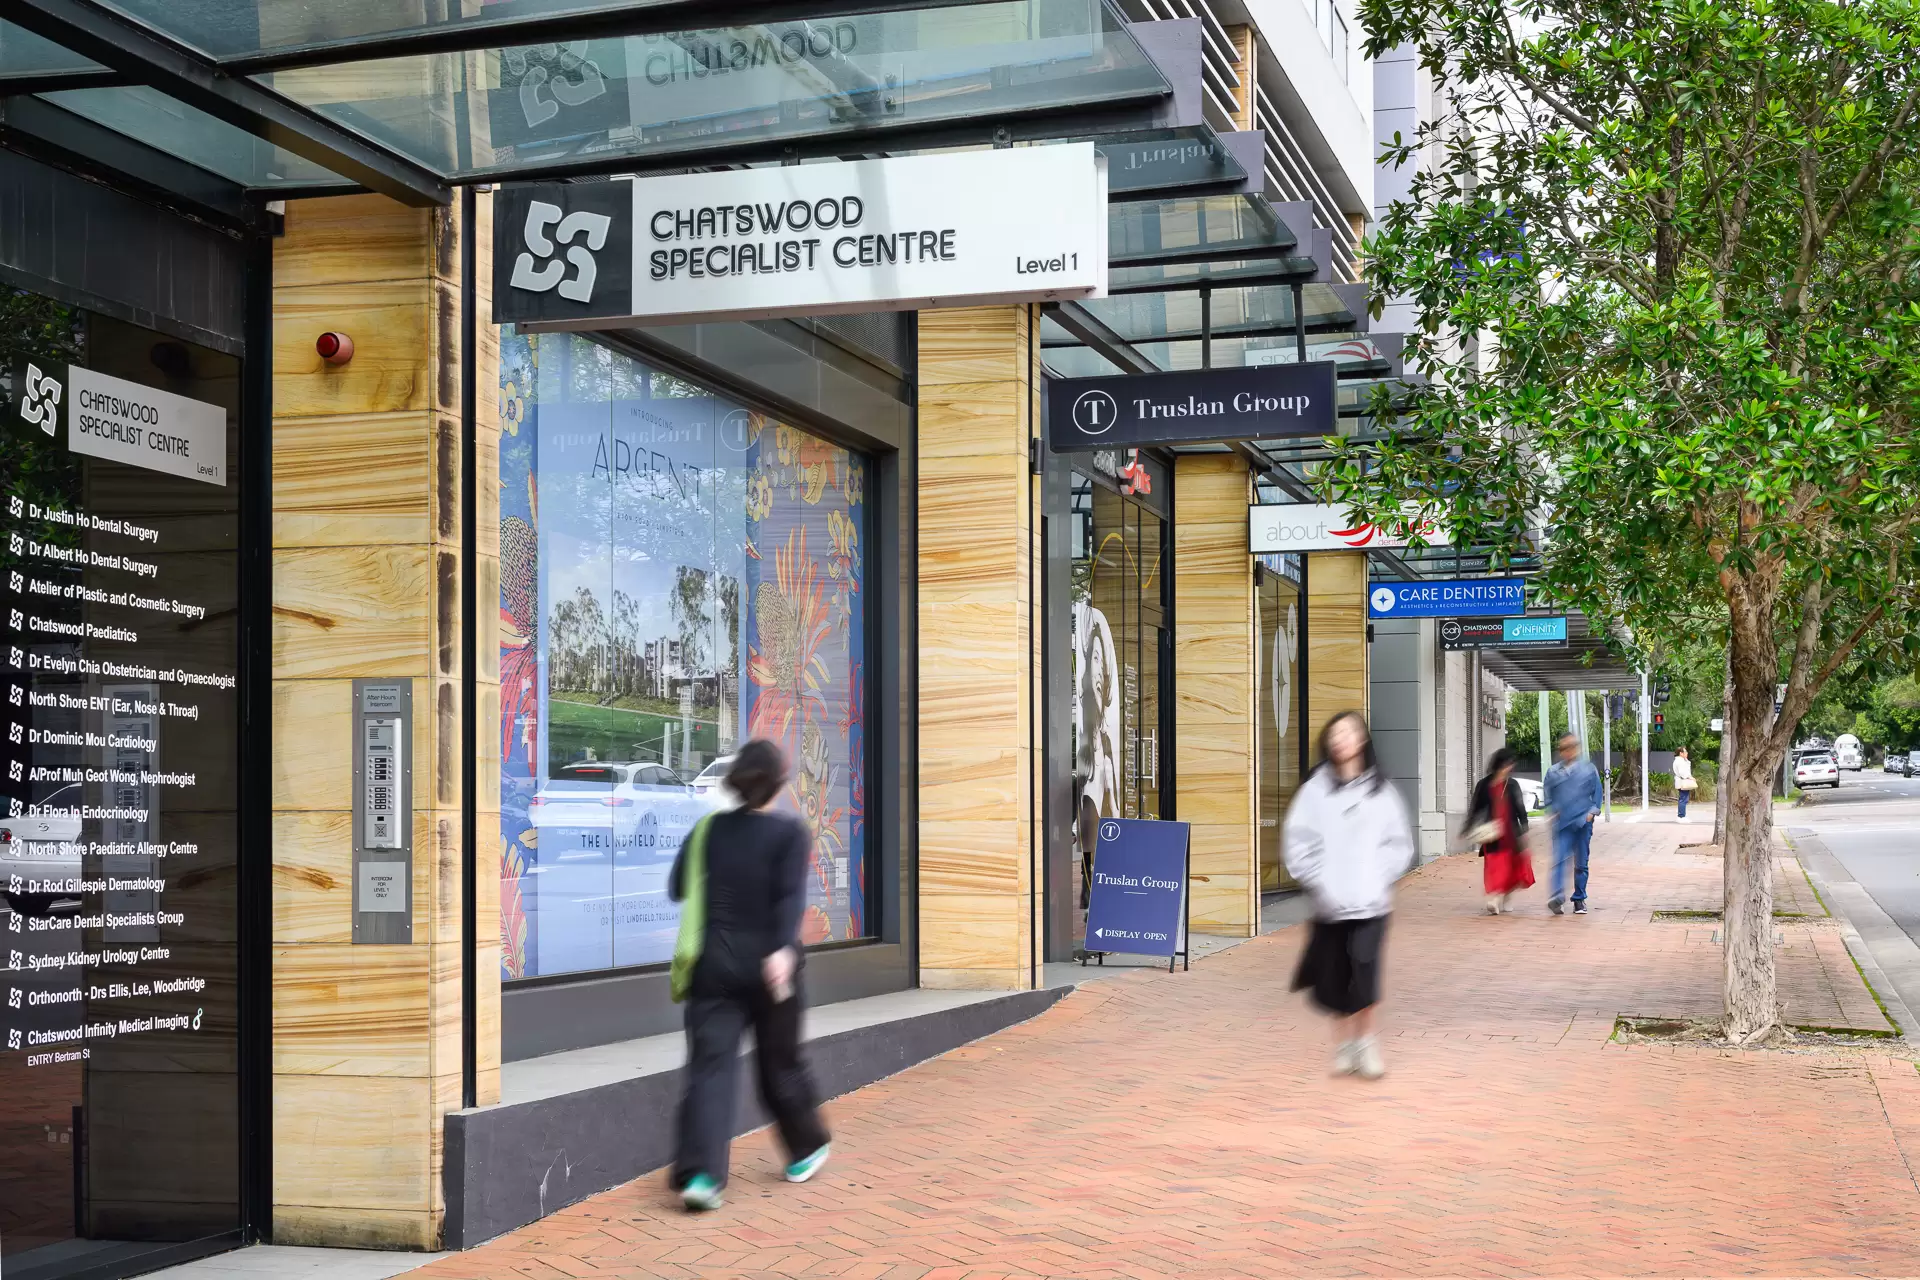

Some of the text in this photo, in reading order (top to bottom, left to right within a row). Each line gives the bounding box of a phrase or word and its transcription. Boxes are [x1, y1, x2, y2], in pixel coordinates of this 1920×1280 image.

[650, 196, 863, 241] CHATSWOOD
[650, 229, 957, 282] SPECIALIST CENTRE
[1017, 253, 1077, 275] Level 1
[80, 390, 158, 425] CHATSWOOD
[1084, 392, 1310, 425] T Truslan Group
[631, 408, 674, 431] INTRODUCING
[80, 415, 190, 458] SPECIALIST CENTRE
[197, 463, 214, 476] Level
[592, 432, 701, 511] ARGENT
[30, 504, 158, 543] Dr Justin Ho Dental Surgery
[1266, 521, 1328, 542] about
[30, 542, 158, 578] Dr Albert Ho Dental Surgery
[29, 579, 205, 620] Atelier of Plastic and Cosmetic Surgery
[1400, 586, 1524, 601] CARE DENTISTRY
[29, 617, 137, 642] Chatswood Paediatrics
[1522, 625, 1558, 633] INFINITY
[29, 654, 235, 690] Dr Evelyn Chia Obstetrician and Gynaecologist
[29, 692, 199, 721] North Shore ENT (Ear, Nose & Throat)
[29, 729, 157, 752] Dr Dominic Mou Cardiology
[29, 767, 196, 788] A/Prof Muh Geot Wong, Nephrologist
[29, 804, 149, 823] Dr Flora Ip Endocrinology
[29, 841, 198, 857] North Shore Paediatric Allergy Centre
[582, 835, 600, 848] THE
[606, 835, 655, 848] LNDFIELD
[29, 876, 166, 895] Dr Rod Gillespie Dermatology
[1096, 873, 1179, 891] Truslan Group
[29, 911, 184, 932] StarCare Dental Specialists Group
[1105, 930, 1168, 941] DISPLAY OPEN
[29, 947, 170, 972] Sydney Kidney Urology Centre
[29, 988, 82, 1006] Orthonorth
[90, 986, 107, 1000] Drs
[109, 984, 131, 999] Ellis,
[133, 982, 152, 997] Lee,
[154, 977, 206, 994] Woodbridge
[28, 1014, 189, 1045] Chatswood Infinity Medical Imaging
[28, 1049, 91, 1067] ENTRY Bertram St
